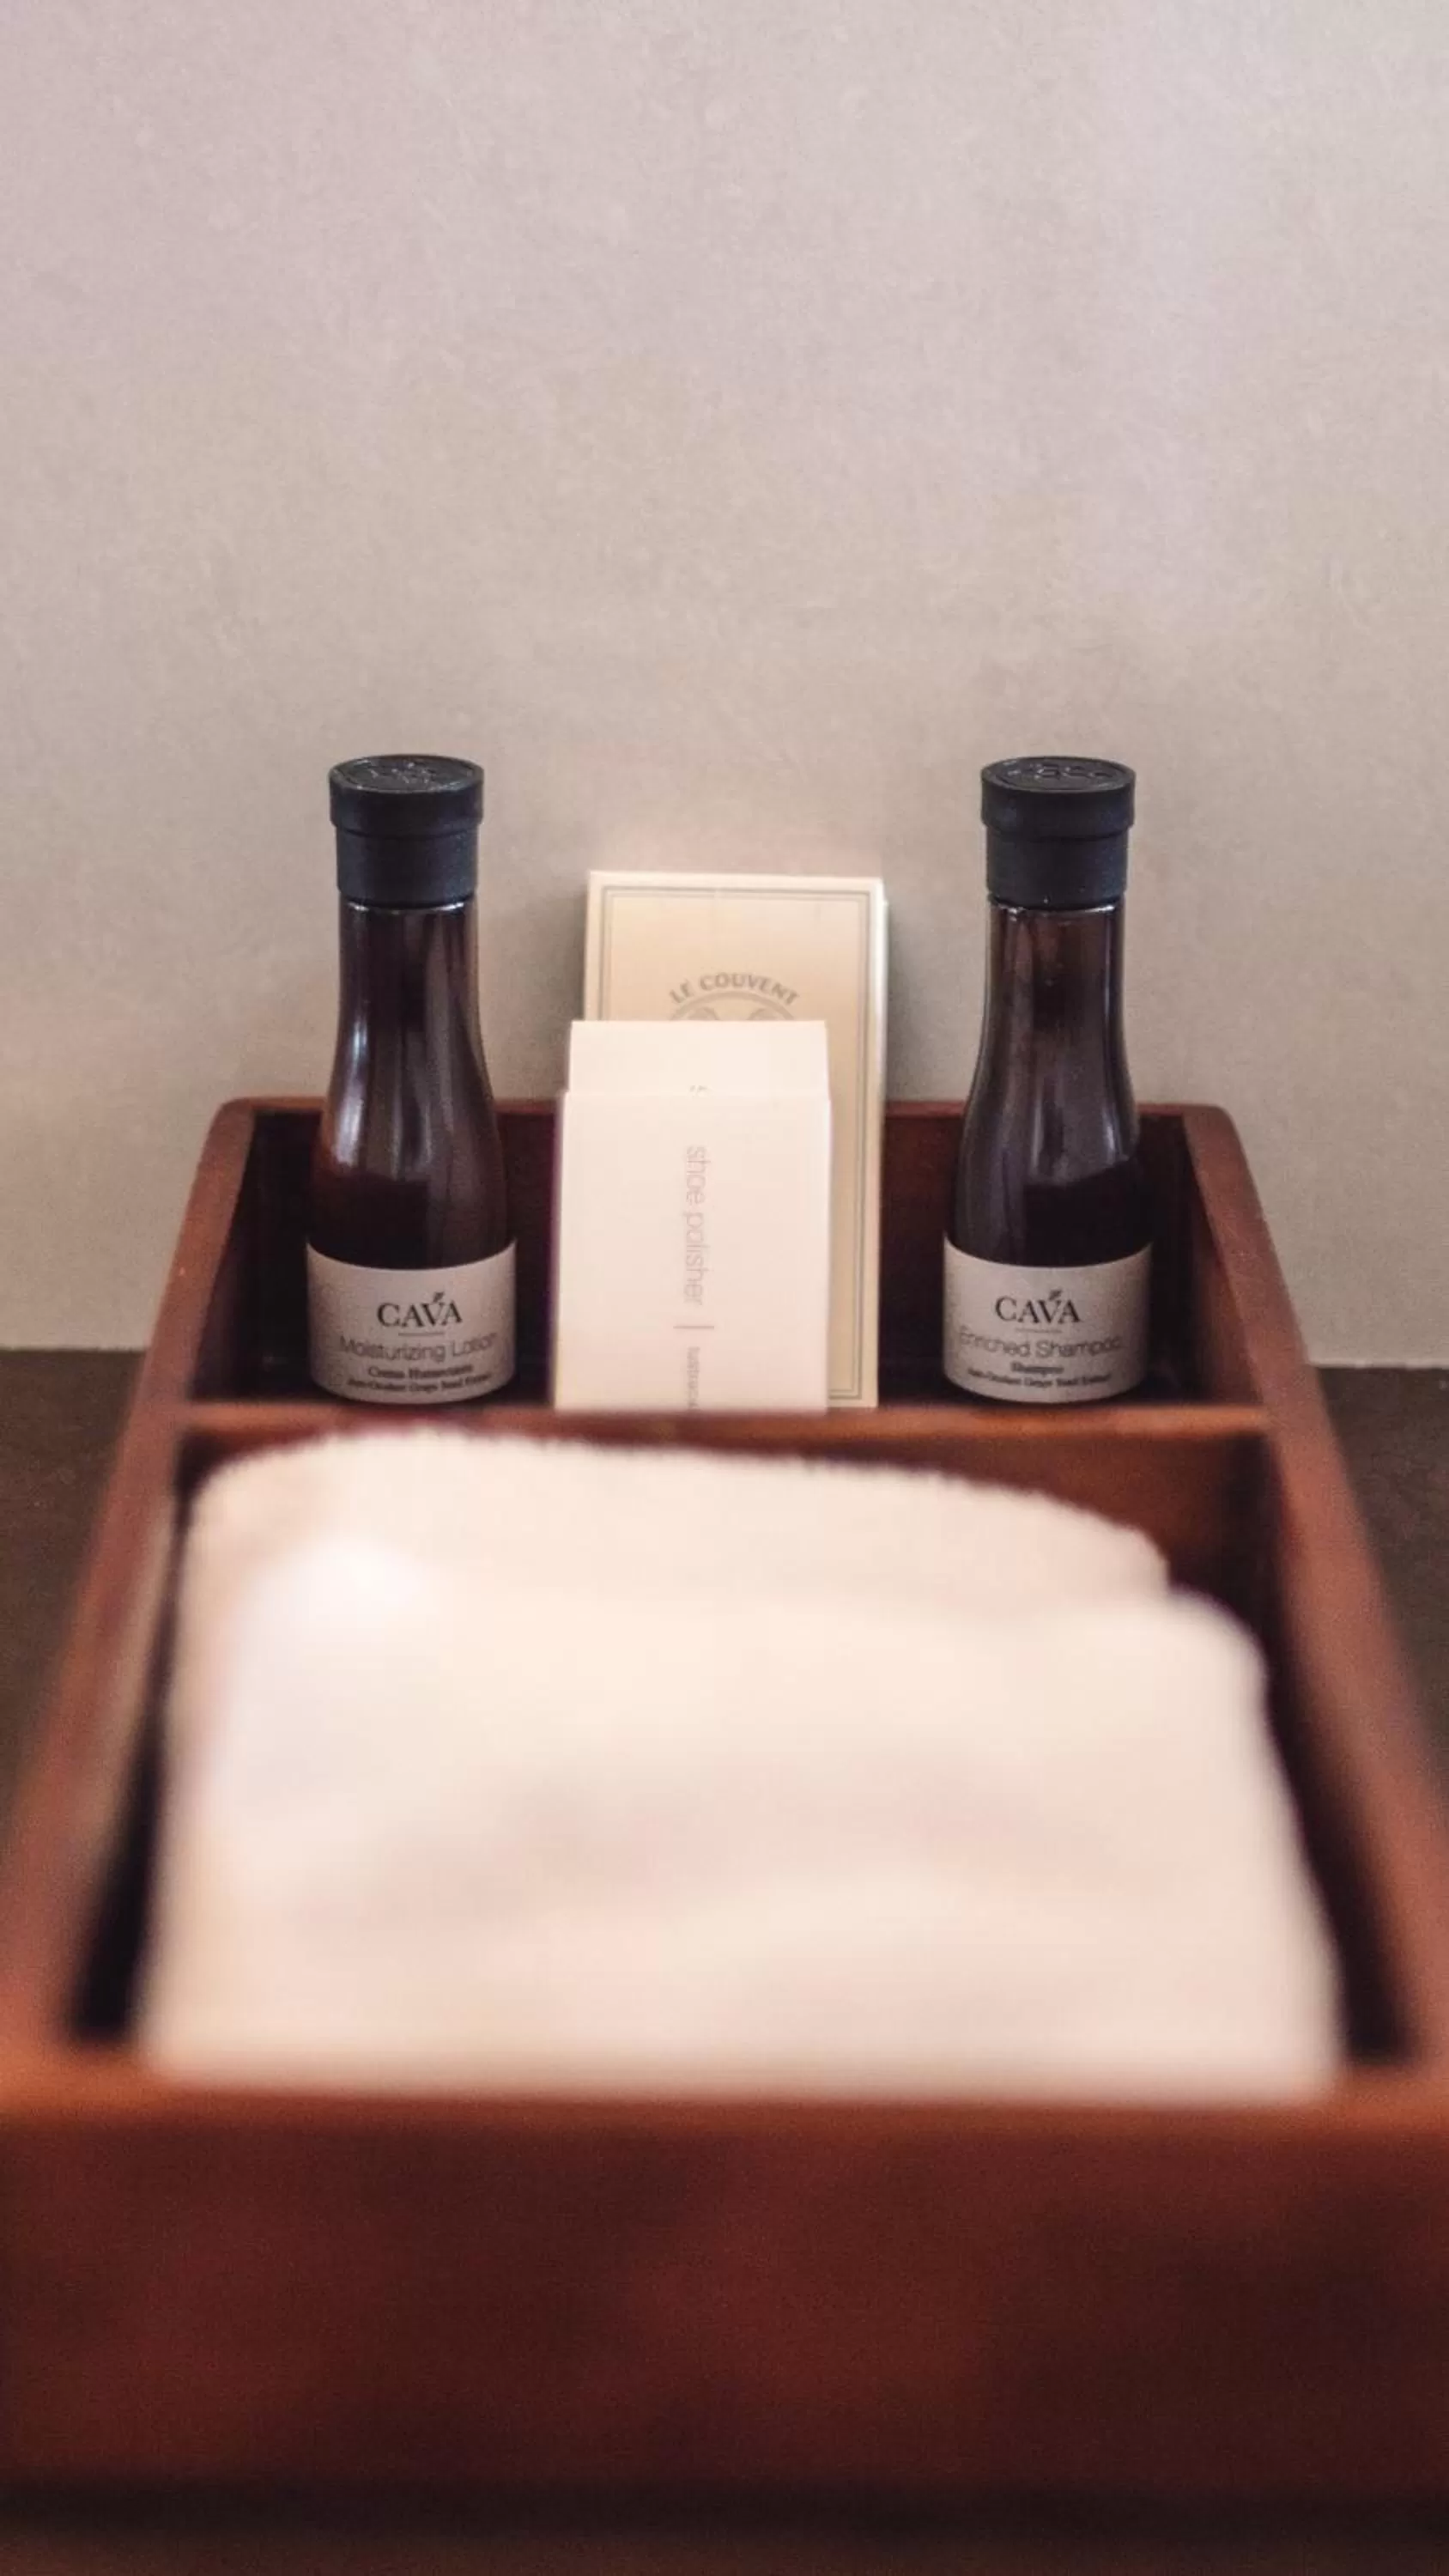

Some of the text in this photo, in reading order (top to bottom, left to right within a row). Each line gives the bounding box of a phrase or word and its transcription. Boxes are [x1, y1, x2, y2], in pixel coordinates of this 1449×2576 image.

[700, 971, 801, 1006] COUVENT
[682, 1145, 712, 1306] shoe polisher
[376, 1291, 464, 1328] CAVA
[994, 1290, 1082, 1325] CAVA
